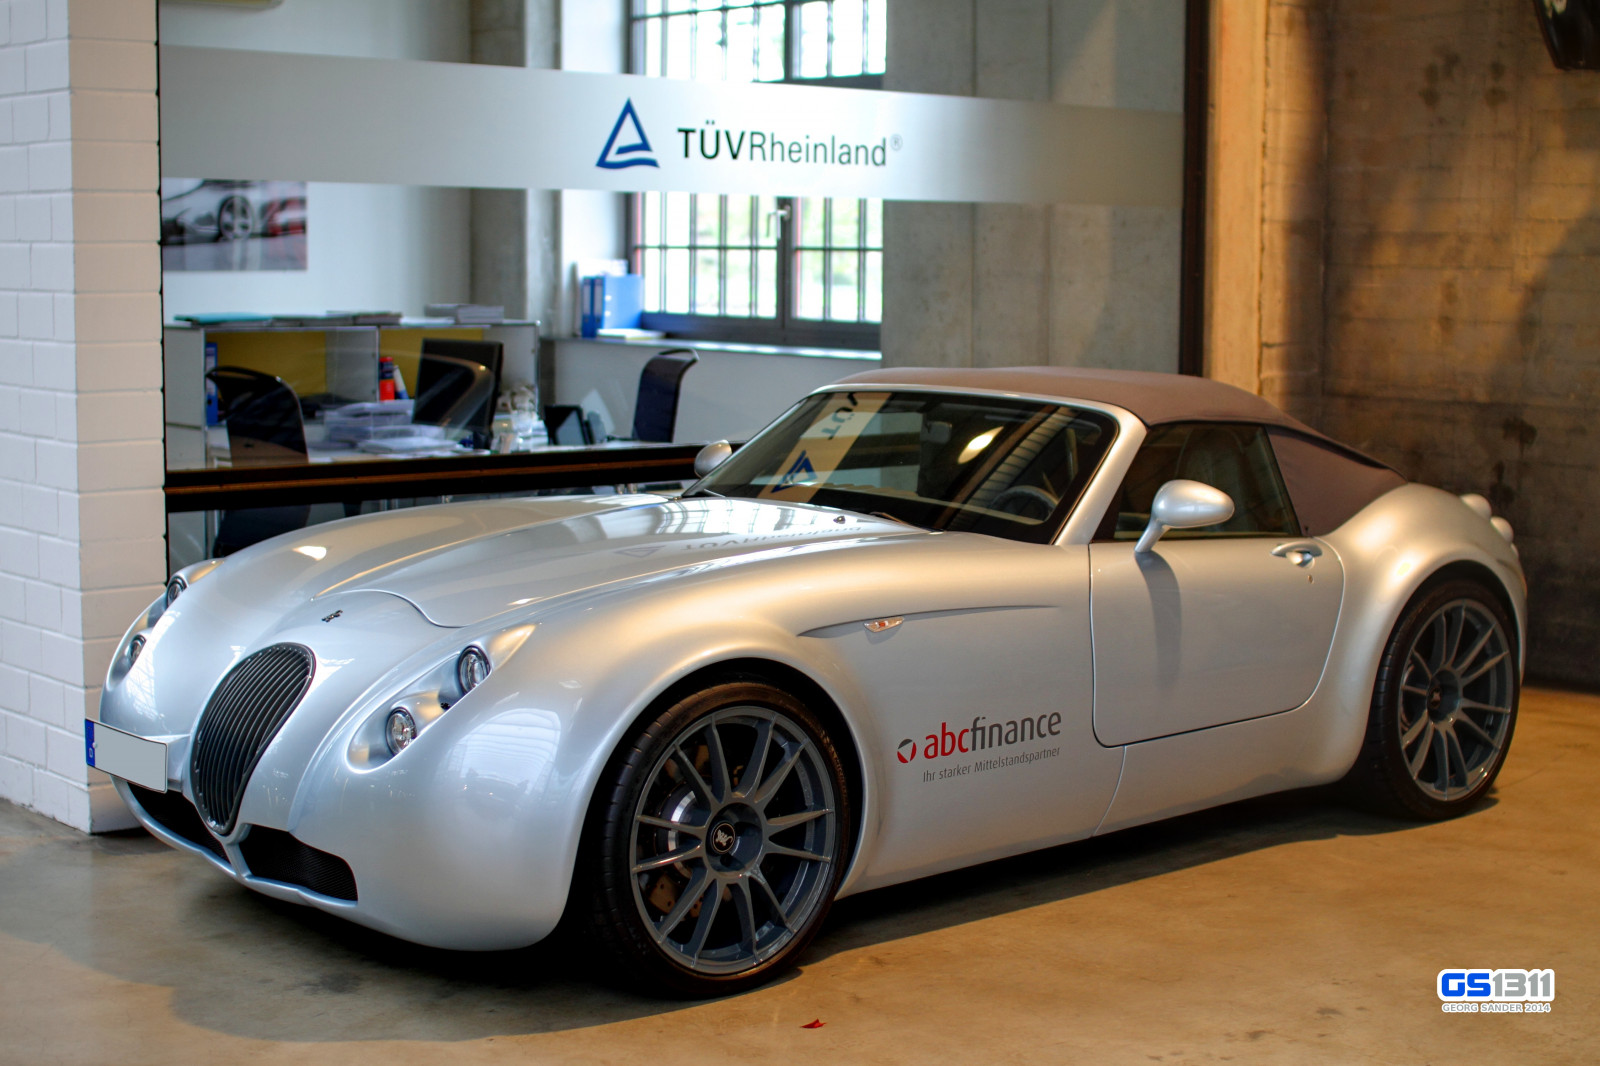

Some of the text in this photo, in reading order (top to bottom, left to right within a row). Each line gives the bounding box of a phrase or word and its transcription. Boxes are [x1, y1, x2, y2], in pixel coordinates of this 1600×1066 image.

[923, 711, 1062, 759] abcfinance
[923, 747, 1061, 783] Ihr starker Mittelstandspartner
